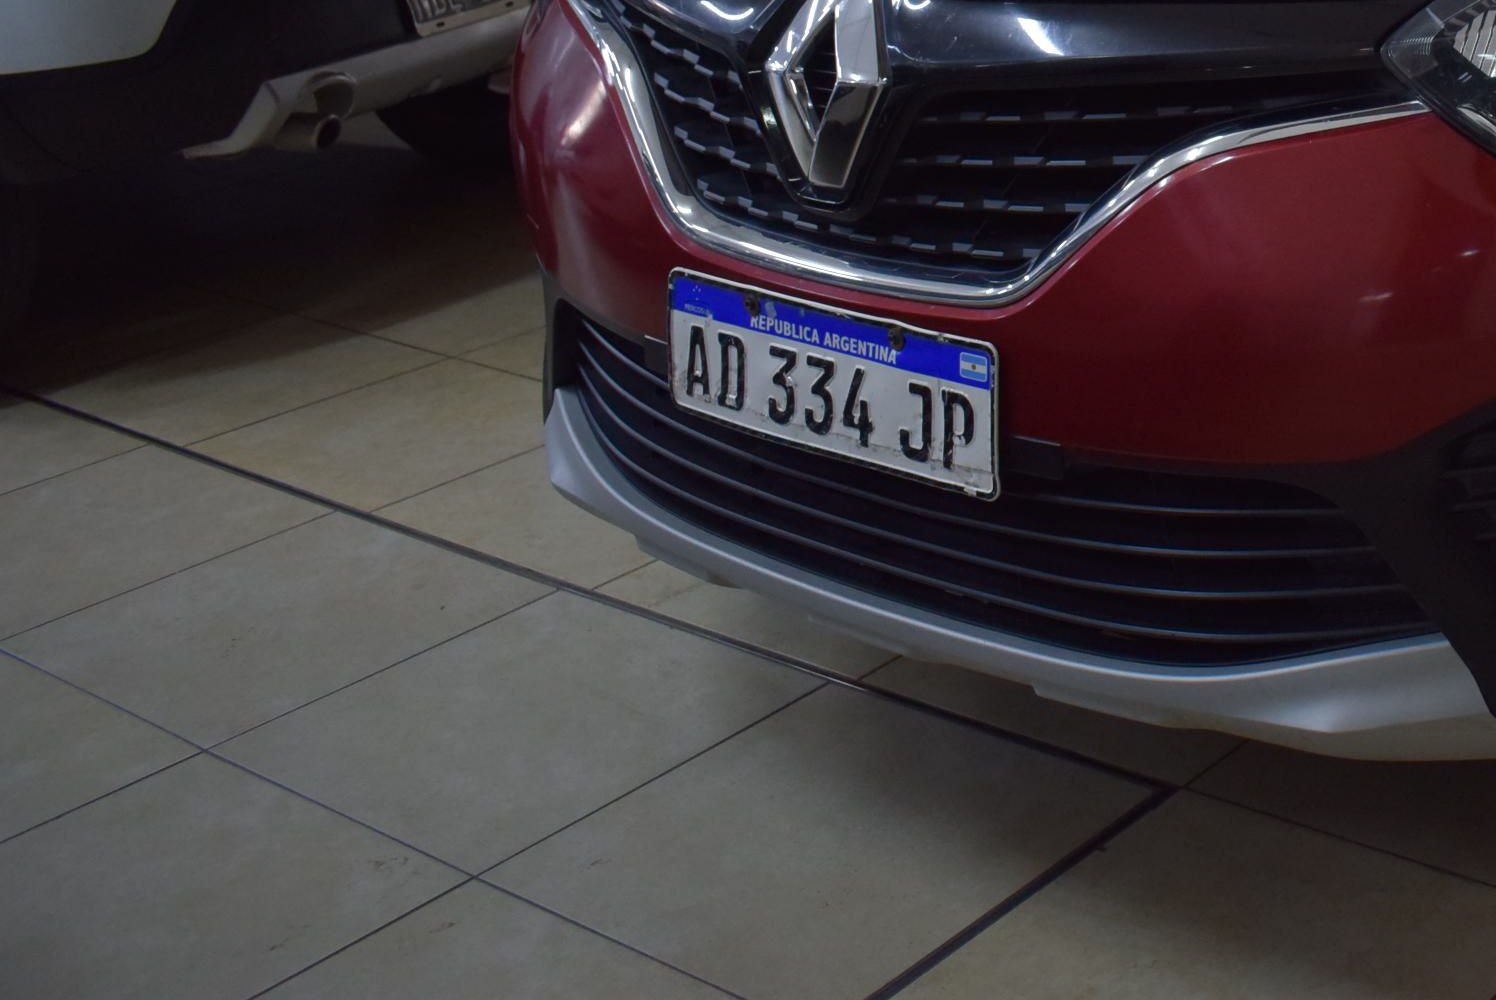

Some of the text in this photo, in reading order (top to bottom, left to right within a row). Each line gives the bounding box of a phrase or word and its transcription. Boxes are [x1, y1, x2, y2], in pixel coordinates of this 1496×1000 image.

[750, 314, 898, 365] REPUBLICA ARGENTINA
[686, 325, 975, 470] AD 334 JP
